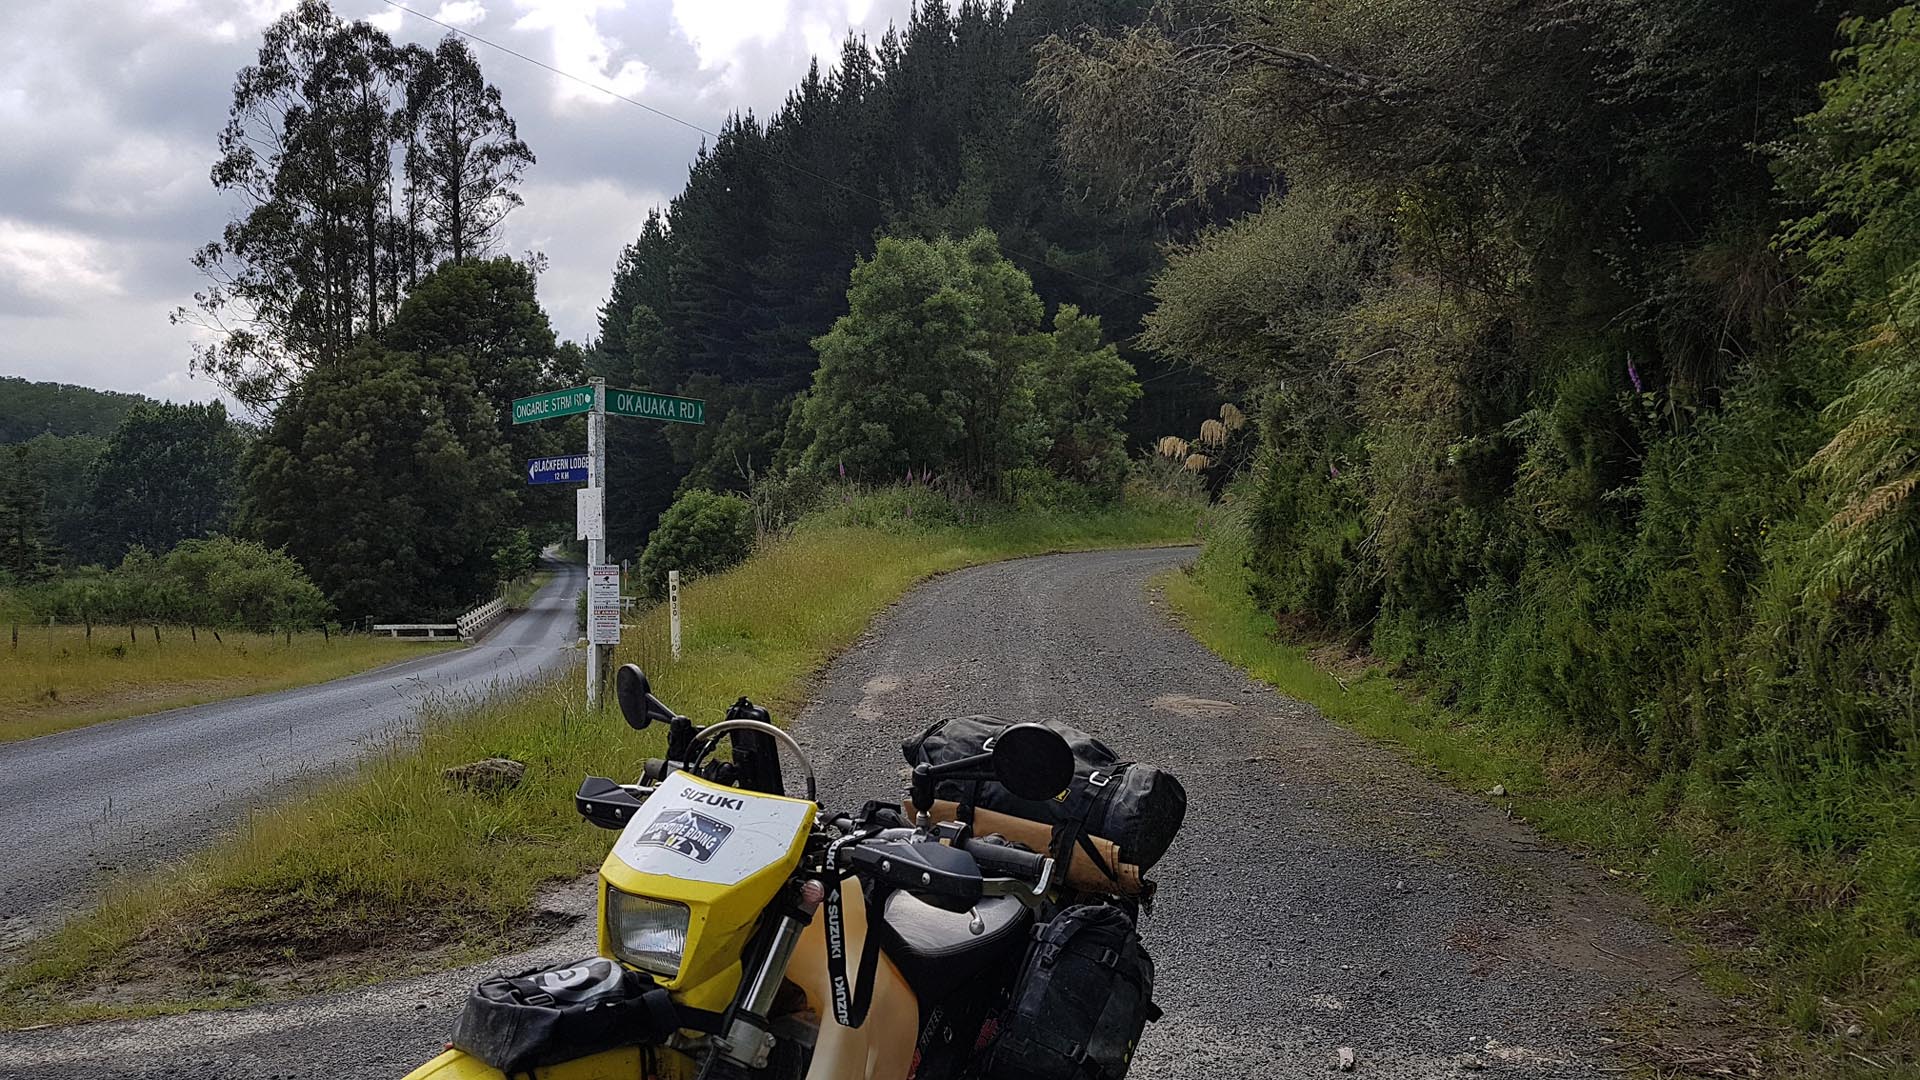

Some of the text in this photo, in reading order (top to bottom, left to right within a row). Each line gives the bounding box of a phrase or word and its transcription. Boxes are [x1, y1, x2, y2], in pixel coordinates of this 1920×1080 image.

[516, 393, 584, 418] ONGARUE STRM RD
[617, 393, 695, 419] OKAUAKA RD
[534, 456, 589, 473] BLACKFERN LODGE
[554, 471, 570, 480] 12 KM
[680, 787, 745, 811] SUZUKI
[685, 827, 717, 850] RIDING
[828, 904, 841, 959] SUZUKI
[834, 976, 849, 1026] SUZUKI
